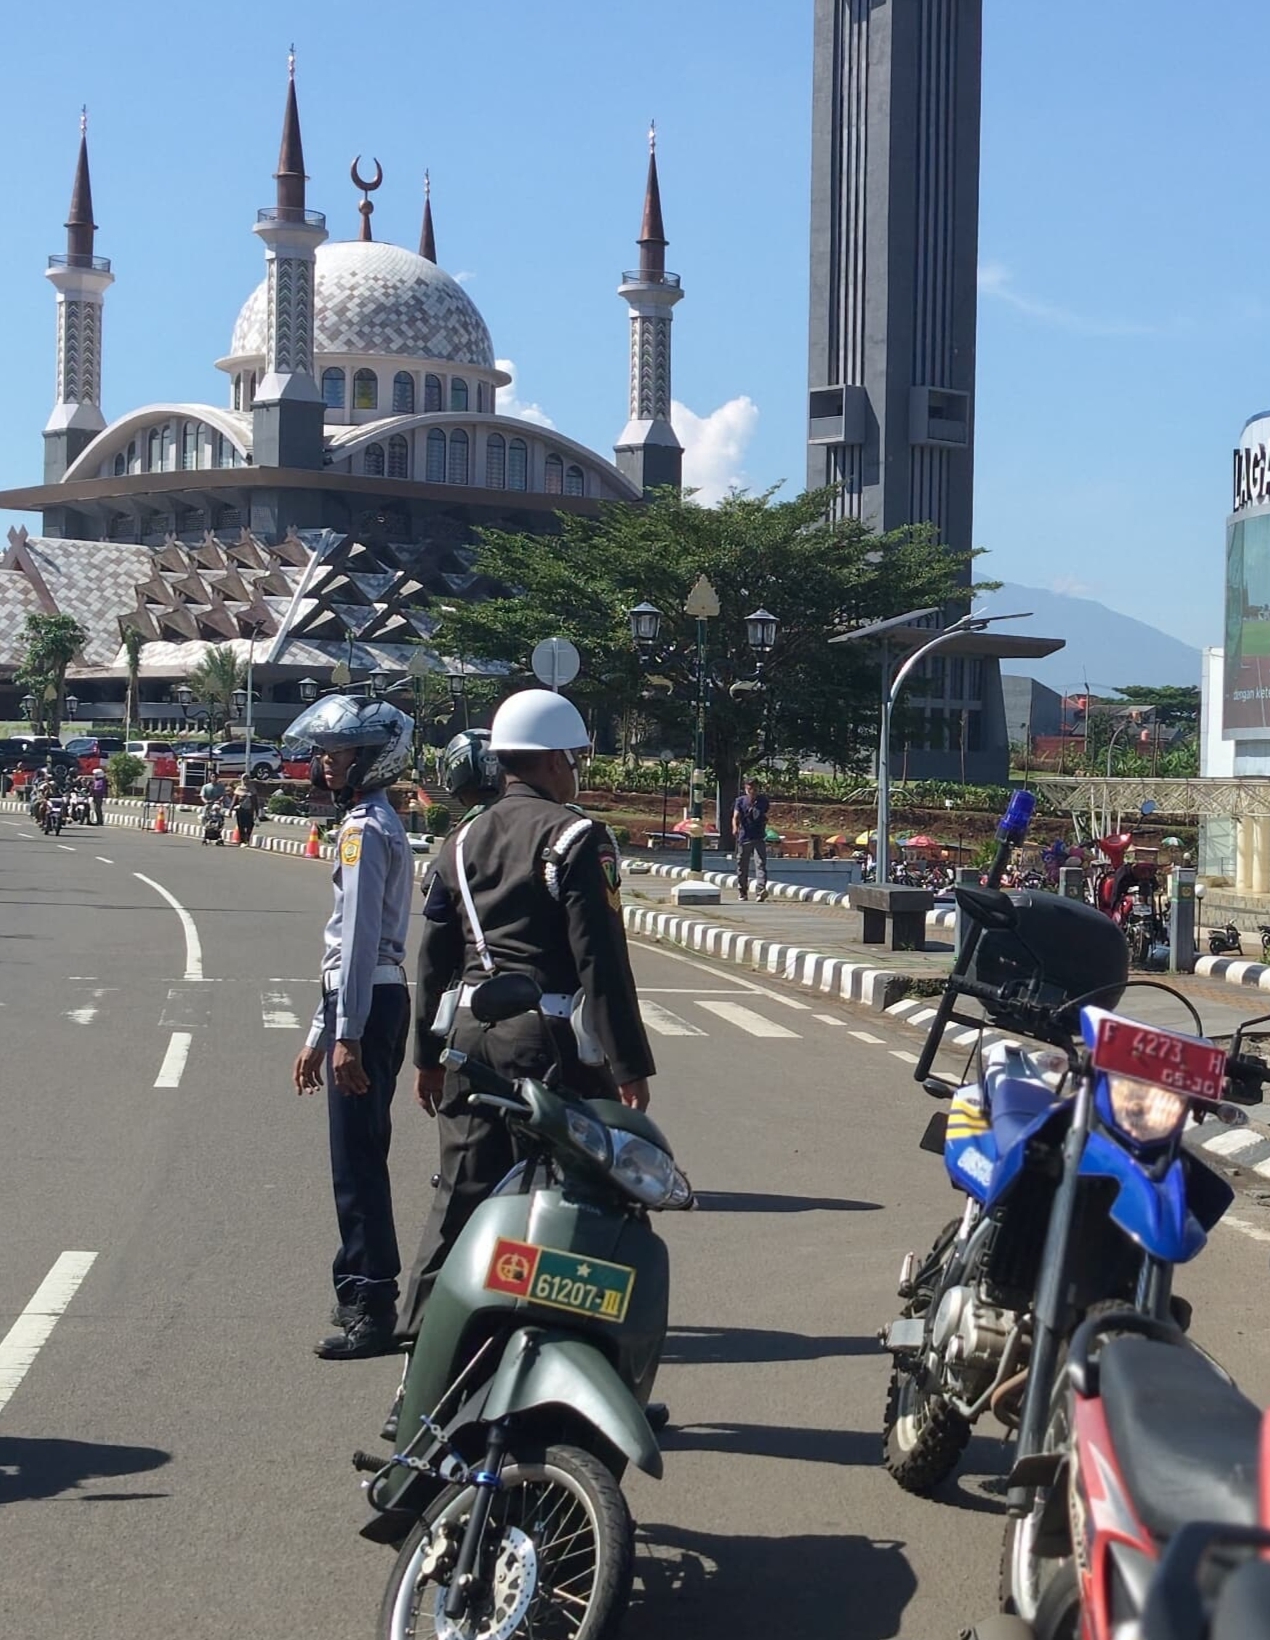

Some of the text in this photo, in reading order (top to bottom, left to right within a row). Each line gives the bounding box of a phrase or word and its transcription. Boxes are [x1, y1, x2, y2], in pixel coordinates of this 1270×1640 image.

[1104, 1022, 1222, 1075] F 4273 H
[536, 1274, 622, 1316] 61207-III
